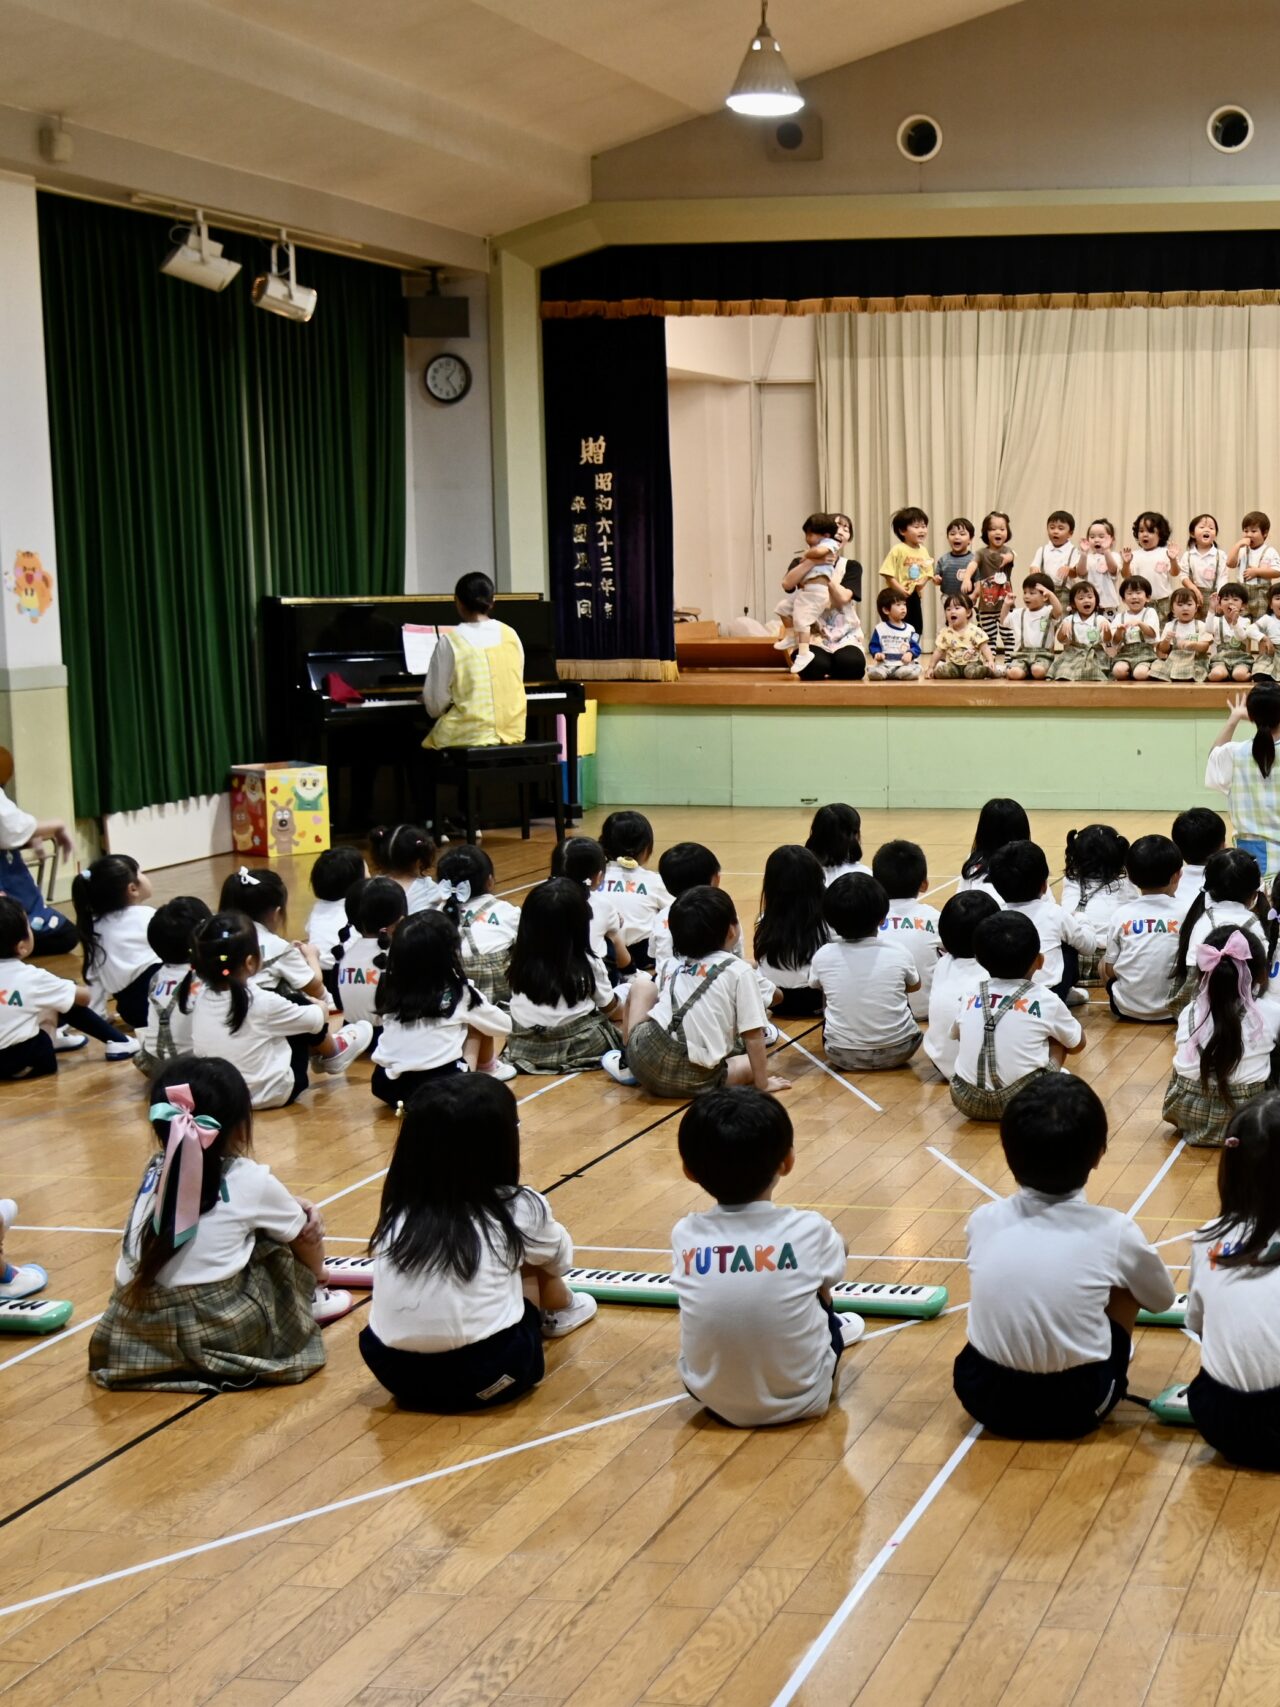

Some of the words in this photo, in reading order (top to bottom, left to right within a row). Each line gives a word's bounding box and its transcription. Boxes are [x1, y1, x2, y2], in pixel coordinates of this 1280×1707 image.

[579, 435, 606, 465] 贈
[879, 917, 935, 934] UTAKA
[1121, 919, 1179, 936] YUTAK
[682, 1242, 798, 1276] YUTAKA
